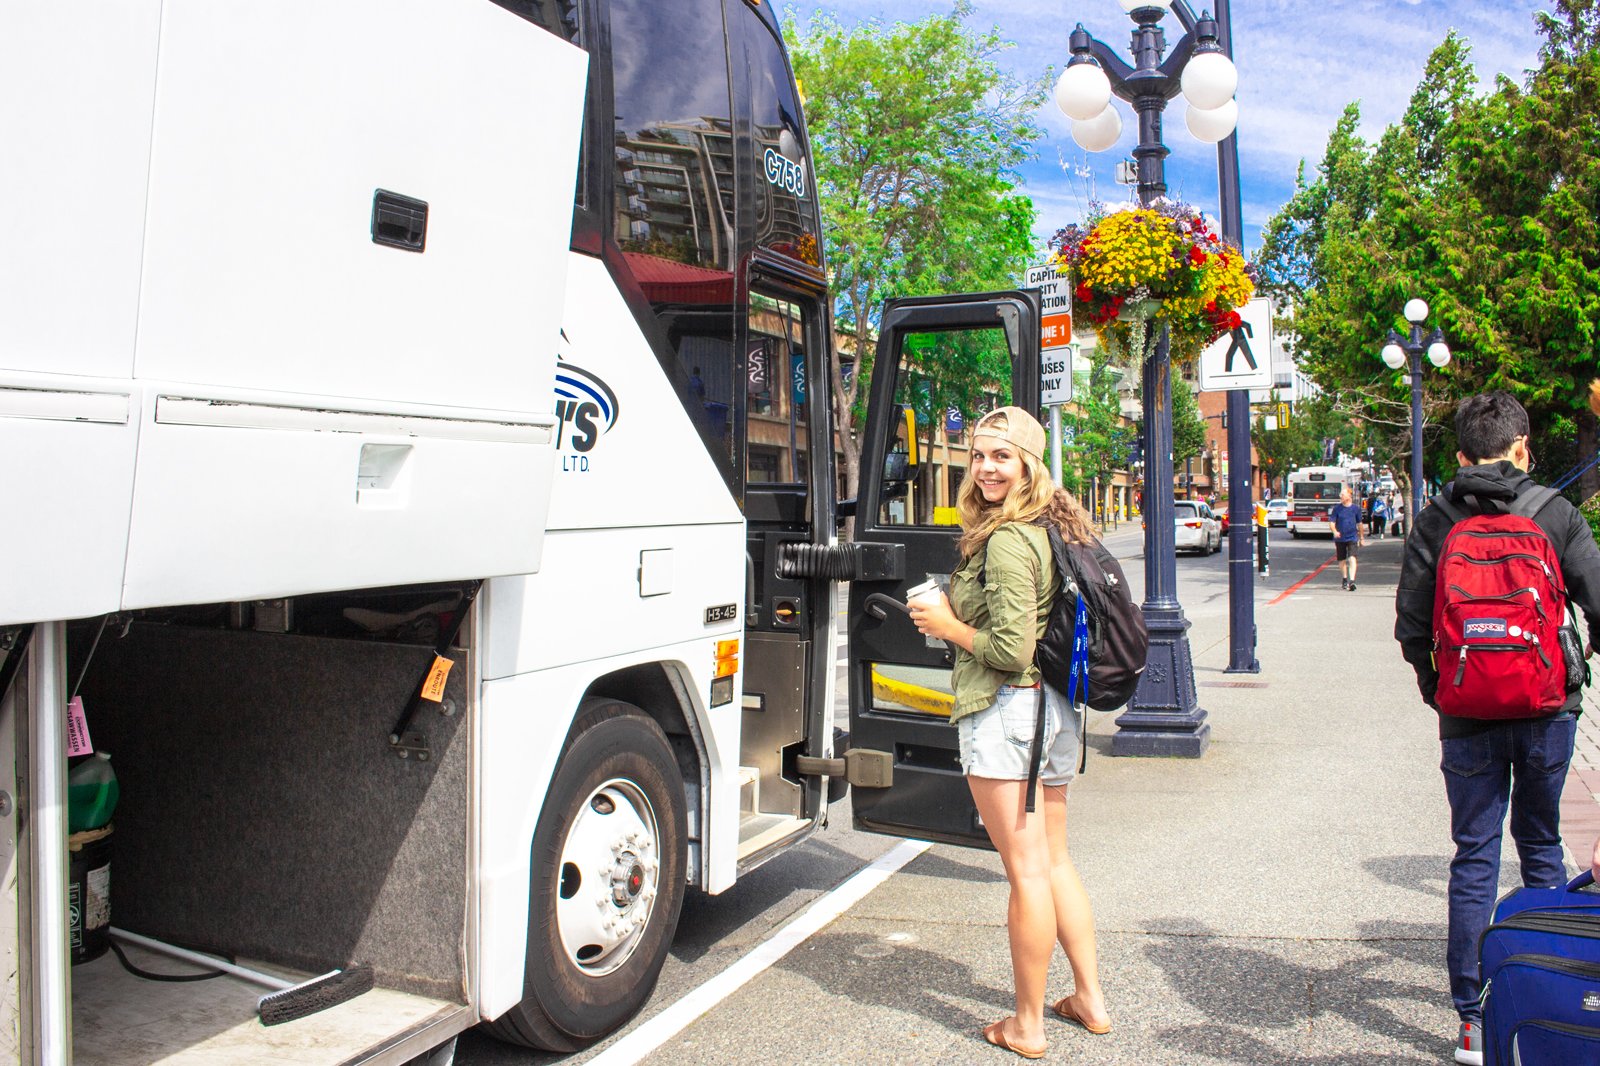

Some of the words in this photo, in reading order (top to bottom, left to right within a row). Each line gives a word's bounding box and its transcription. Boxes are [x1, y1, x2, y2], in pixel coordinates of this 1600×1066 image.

[764, 148, 804, 197] C758
[1030, 269, 1066, 283] CAPITAL
[1039, 283, 1058, 295] CITY
[1041, 296, 1066, 308] ATION
[1042, 325, 1057, 339] ONE
[1060, 324, 1065, 336] 1
[1041, 361, 1065, 374] USES
[563, 455, 590, 472] LTD.
[68, 711, 80, 752] TSAWWASSEN
